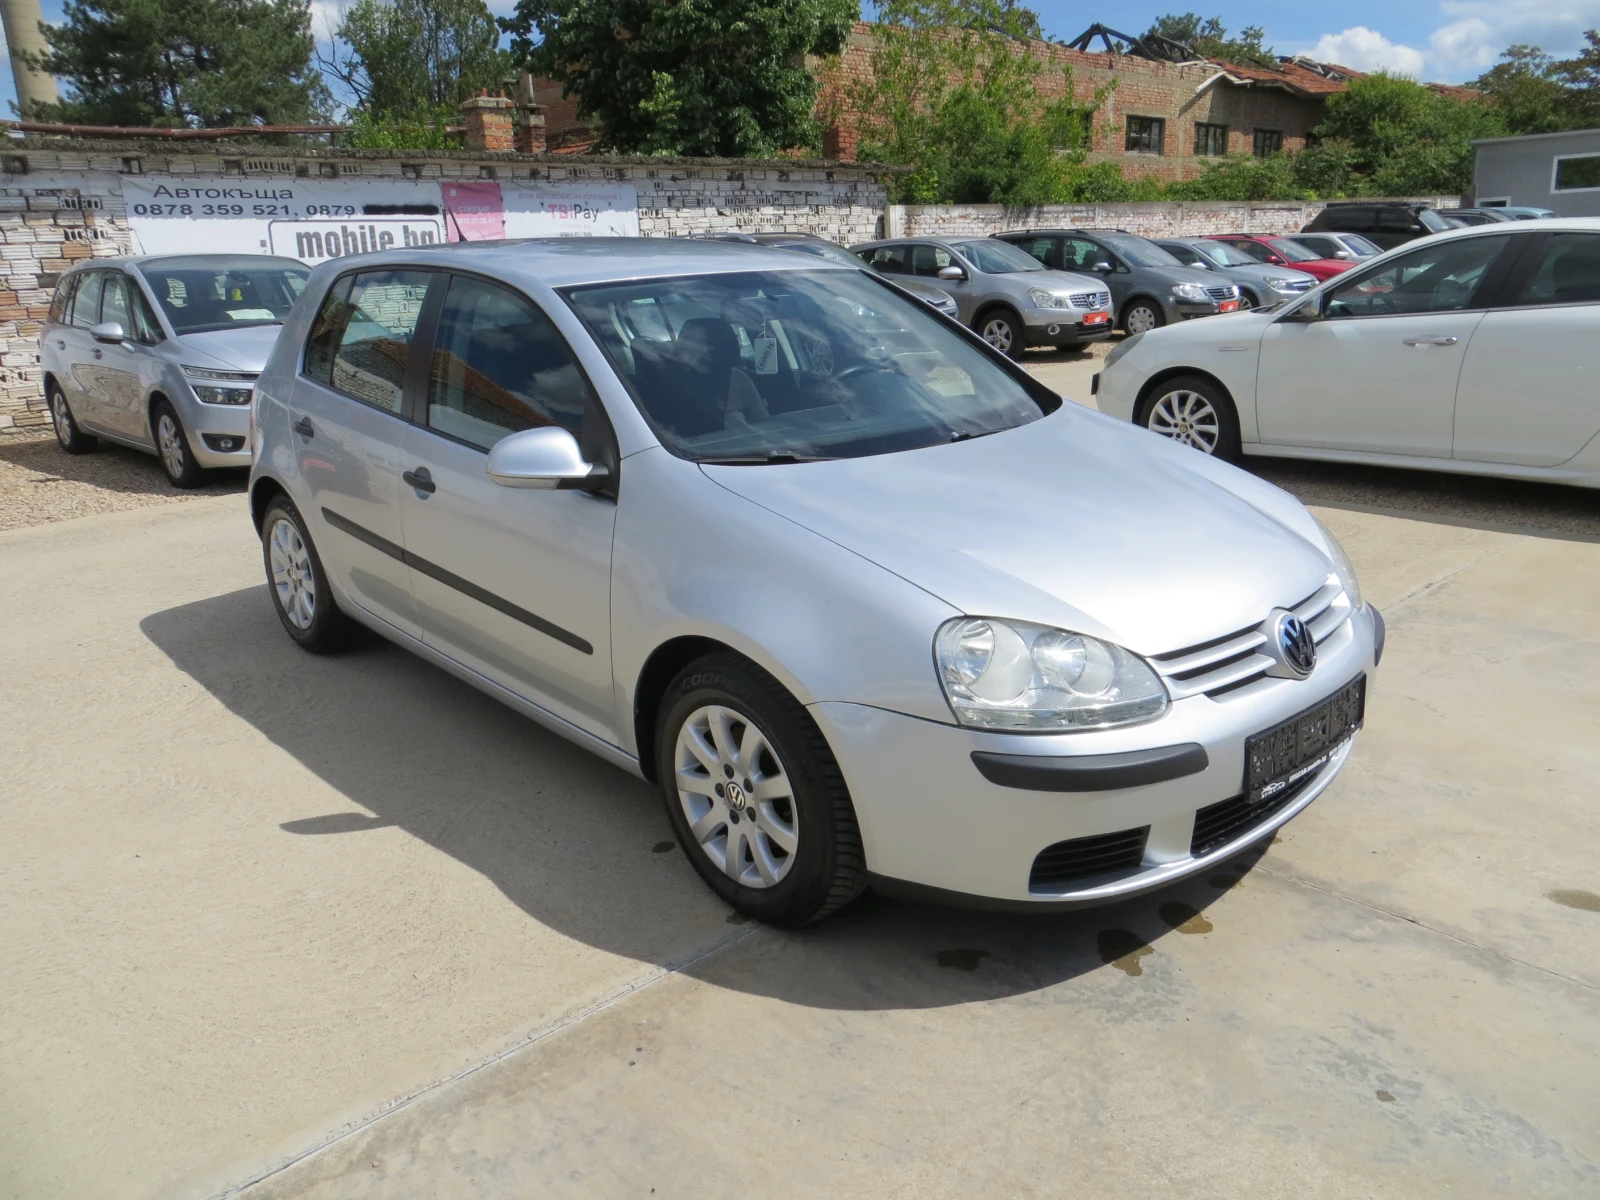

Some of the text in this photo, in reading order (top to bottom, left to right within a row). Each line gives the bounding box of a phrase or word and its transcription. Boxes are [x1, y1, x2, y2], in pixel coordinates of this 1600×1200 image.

[153, 185, 294, 201] Автокъща
[133, 204, 194, 216] 0878
[202, 204, 244, 216] 359
[306, 204, 356, 216] 0879
[296, 225, 434, 258] mobileb
